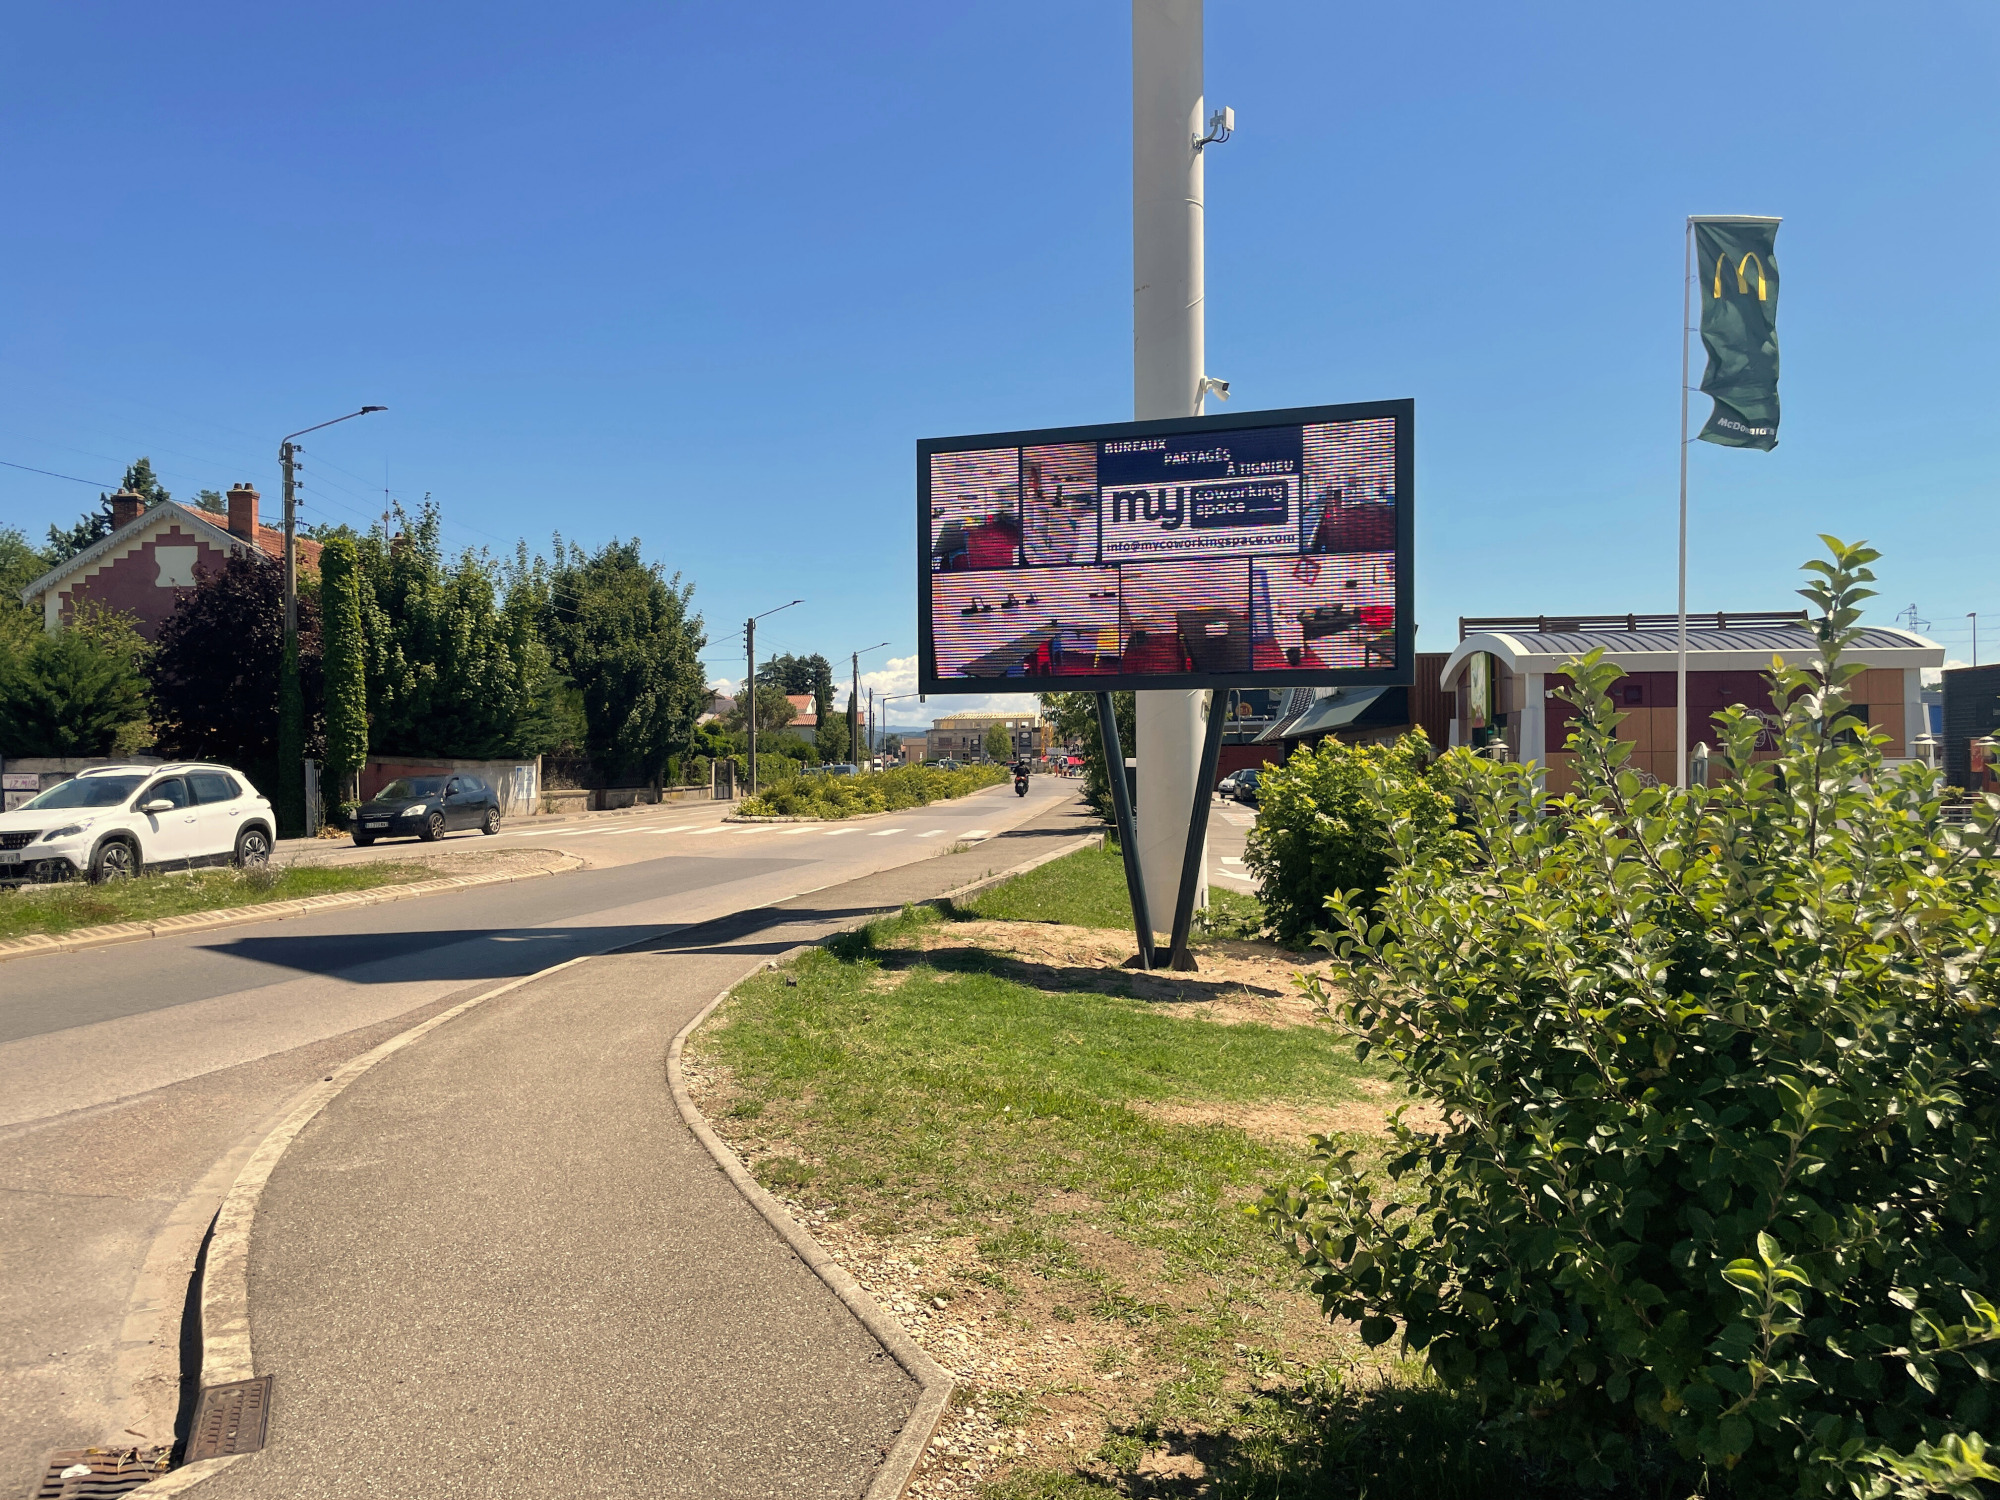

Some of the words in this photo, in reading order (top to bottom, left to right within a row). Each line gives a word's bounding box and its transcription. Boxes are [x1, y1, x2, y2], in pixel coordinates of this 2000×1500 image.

[1104, 439, 1167, 454] BUREAUX
[1240, 460, 1294, 475] TIGNIEU
[1195, 484, 1283, 502] coworking
[1112, 488, 1185, 530] my
[1195, 502, 1246, 519] space
[1106, 534, 1296, 552] info@mycoworkingspace.com
